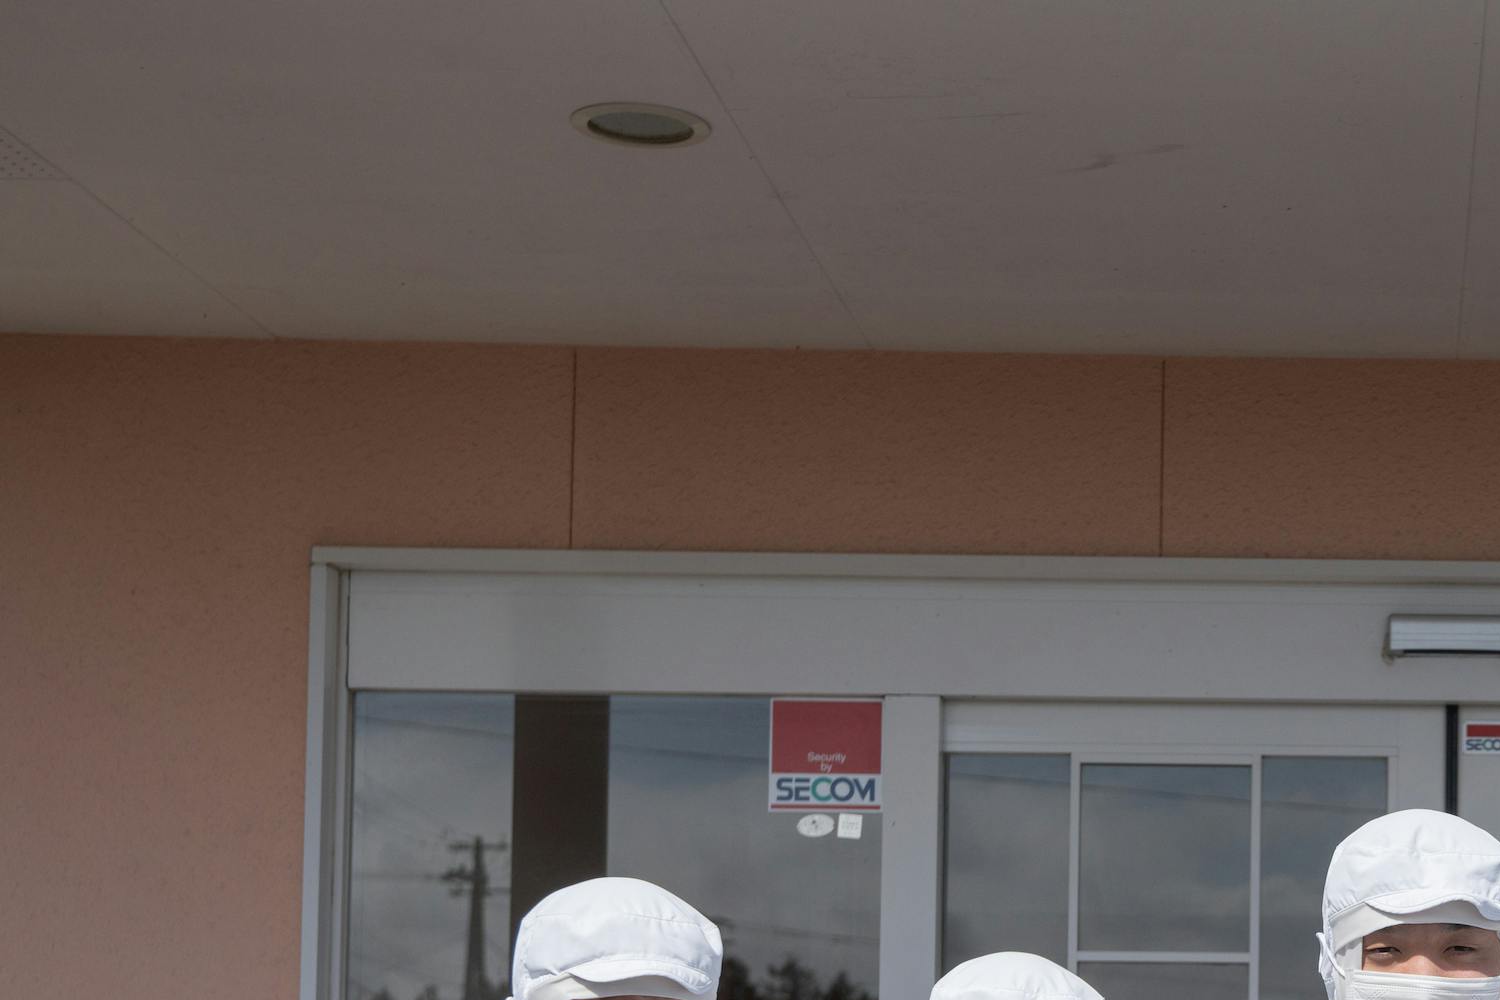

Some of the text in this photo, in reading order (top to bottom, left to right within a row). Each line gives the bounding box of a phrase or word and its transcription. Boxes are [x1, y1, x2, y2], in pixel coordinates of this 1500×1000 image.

[807, 752, 846, 764] Security
[820, 762, 832, 774] by
[776, 777, 876, 802] SECOM
